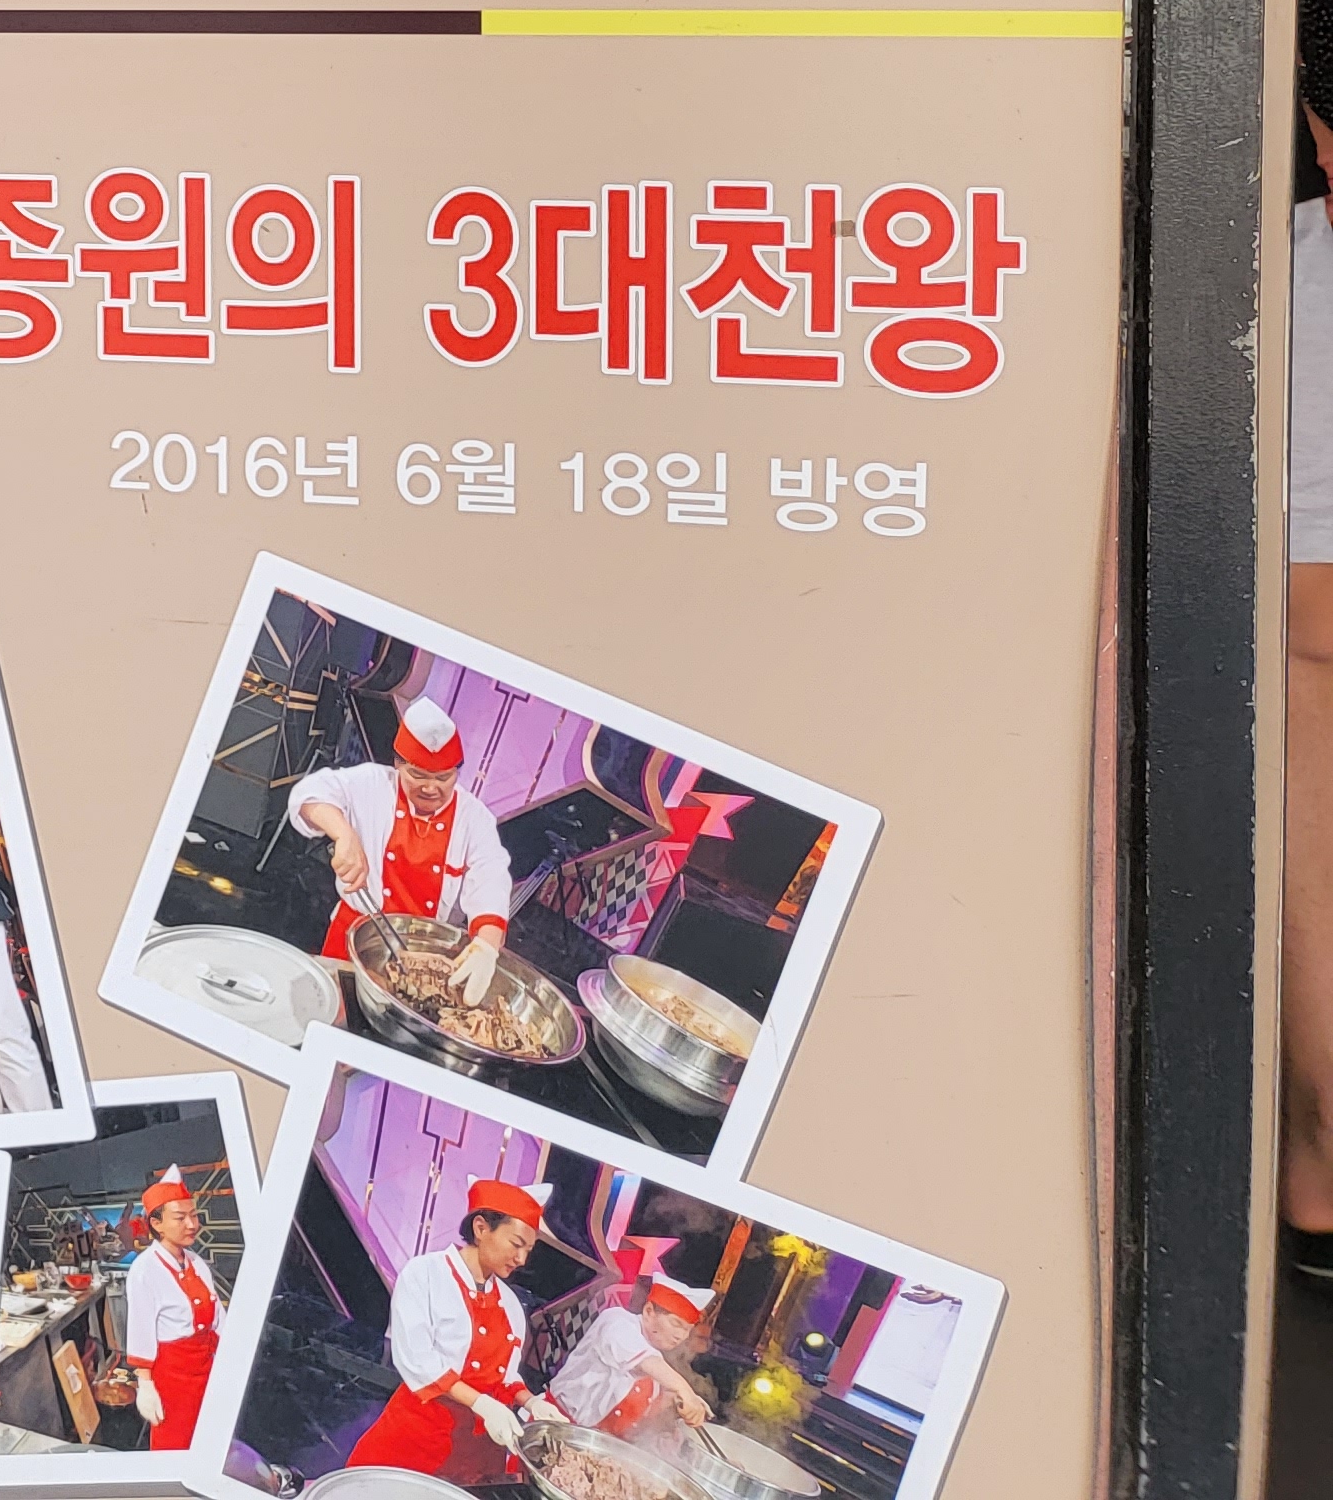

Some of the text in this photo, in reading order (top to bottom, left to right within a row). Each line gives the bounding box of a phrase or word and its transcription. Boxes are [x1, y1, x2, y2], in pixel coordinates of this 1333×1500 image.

[423, 179, 1027, 398] 3대천왕
[109, 430, 930, 538] 2016년 6월 18일 방영
